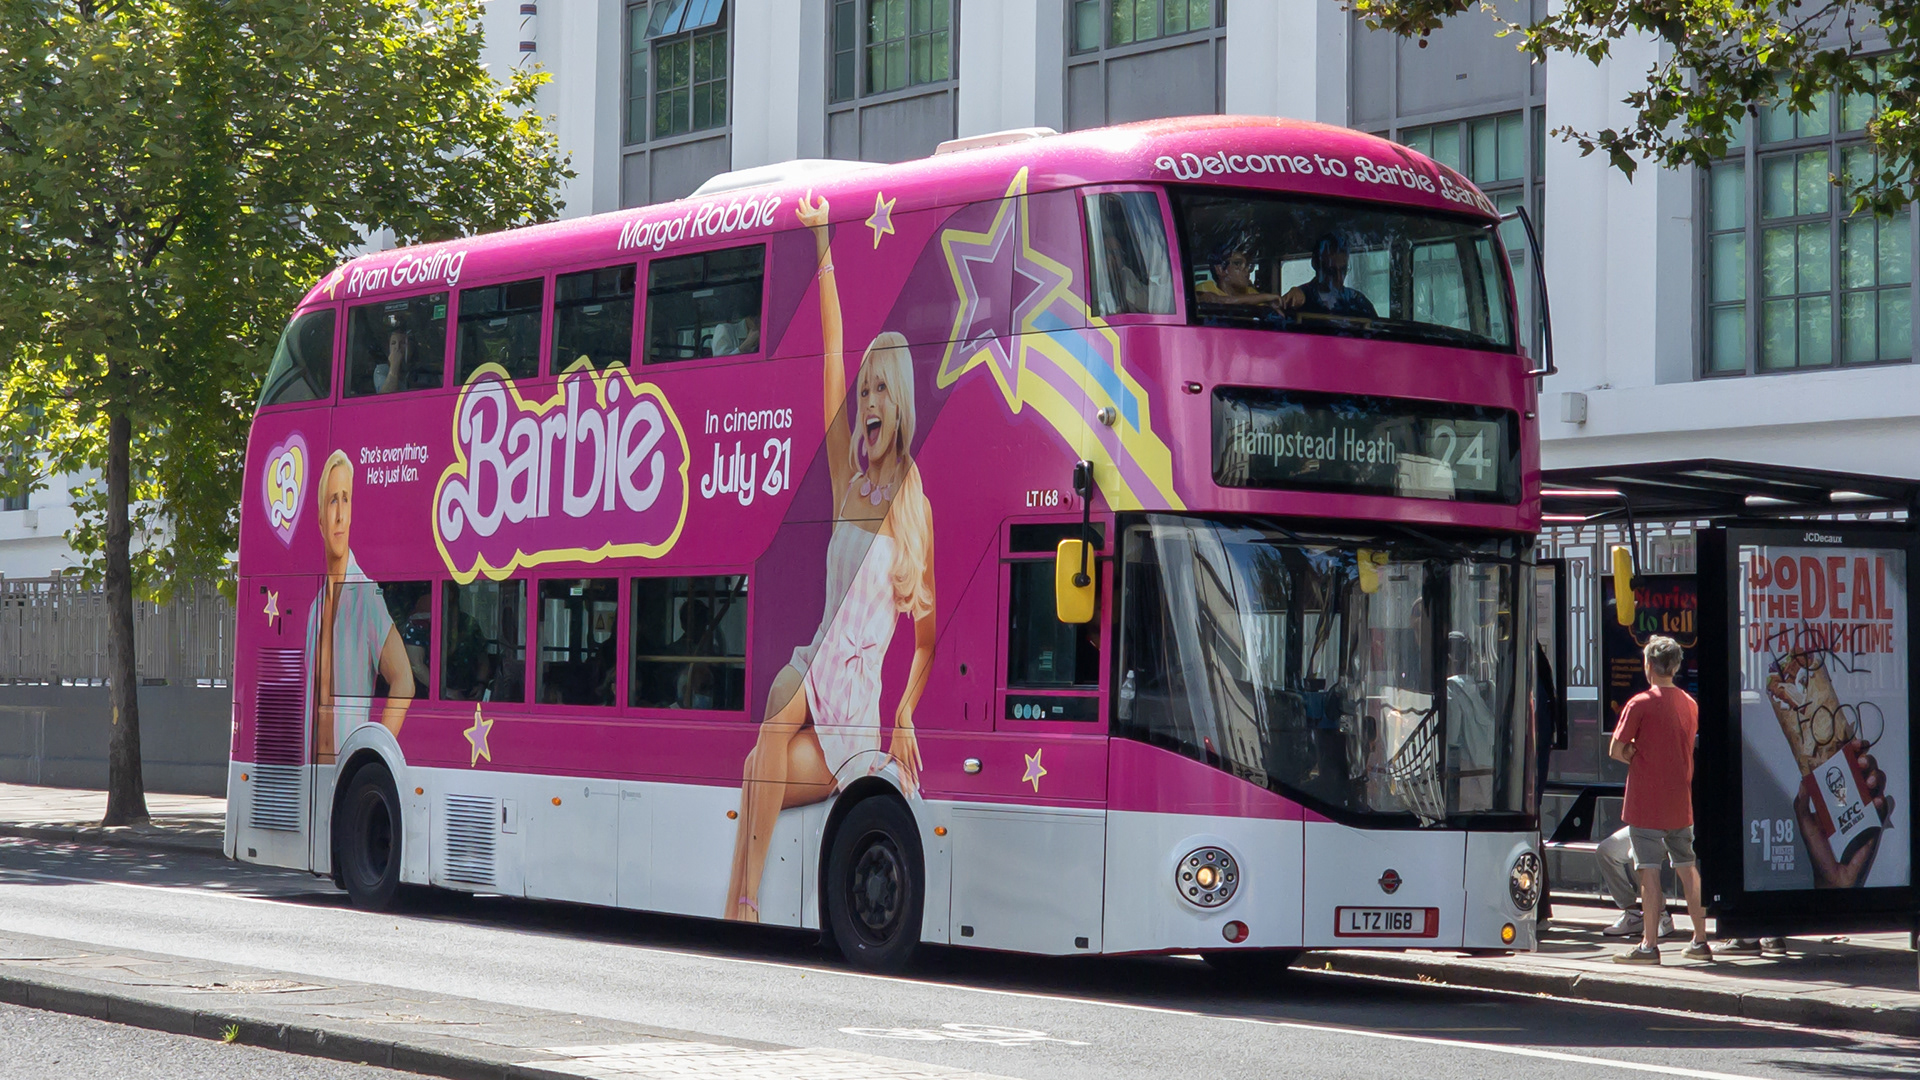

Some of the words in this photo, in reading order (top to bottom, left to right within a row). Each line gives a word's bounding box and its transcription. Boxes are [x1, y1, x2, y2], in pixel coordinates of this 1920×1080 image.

[1155, 151, 1312, 181] Welcome
[1314, 153, 1348, 178] to
[1354, 156, 1435, 193] Barbie
[617, 210, 692, 251] Margot
[690, 192, 782, 237] Robbie
[347, 266, 389, 298] Ryan
[391, 248, 468, 287] Gosling
[705, 409, 719, 434] In
[723, 406, 793, 433] cinemas
[360, 446, 381, 464] She's
[382, 442, 429, 464] everything.
[439, 375, 666, 542] Barbie
[1233, 418, 1337, 467] Hampstead
[1343, 427, 1396, 464] Heath
[1433, 424, 1492, 481] 24
[366, 466, 384, 485] He's
[384, 465, 400, 488] just
[401, 464, 419, 482] Ken.
[700, 440, 757, 506] July
[761, 437, 791, 496] 21
[1026, 489, 1059, 507] LT168
[1803, 532, 1843, 544] JCDecaux
[1749, 555, 1799, 591] DO
[1800, 556, 1894, 620] DEAL
[1639, 610, 1658, 632] to
[1662, 609, 1693, 632] tell
[1749, 594, 1799, 619] THE
[1748, 622, 1773, 653] OF
[1778, 622, 1790, 653] A
[1793, 622, 1894, 653] LUNCHTIME
[1793, 701, 1885, 748] FOOD
[1837, 801, 1862, 829] KFC
[1750, 819, 1794, 861] £1.98
[1352, 911, 1382, 930] LTZ
[1385, 911, 1413, 930] 1168
